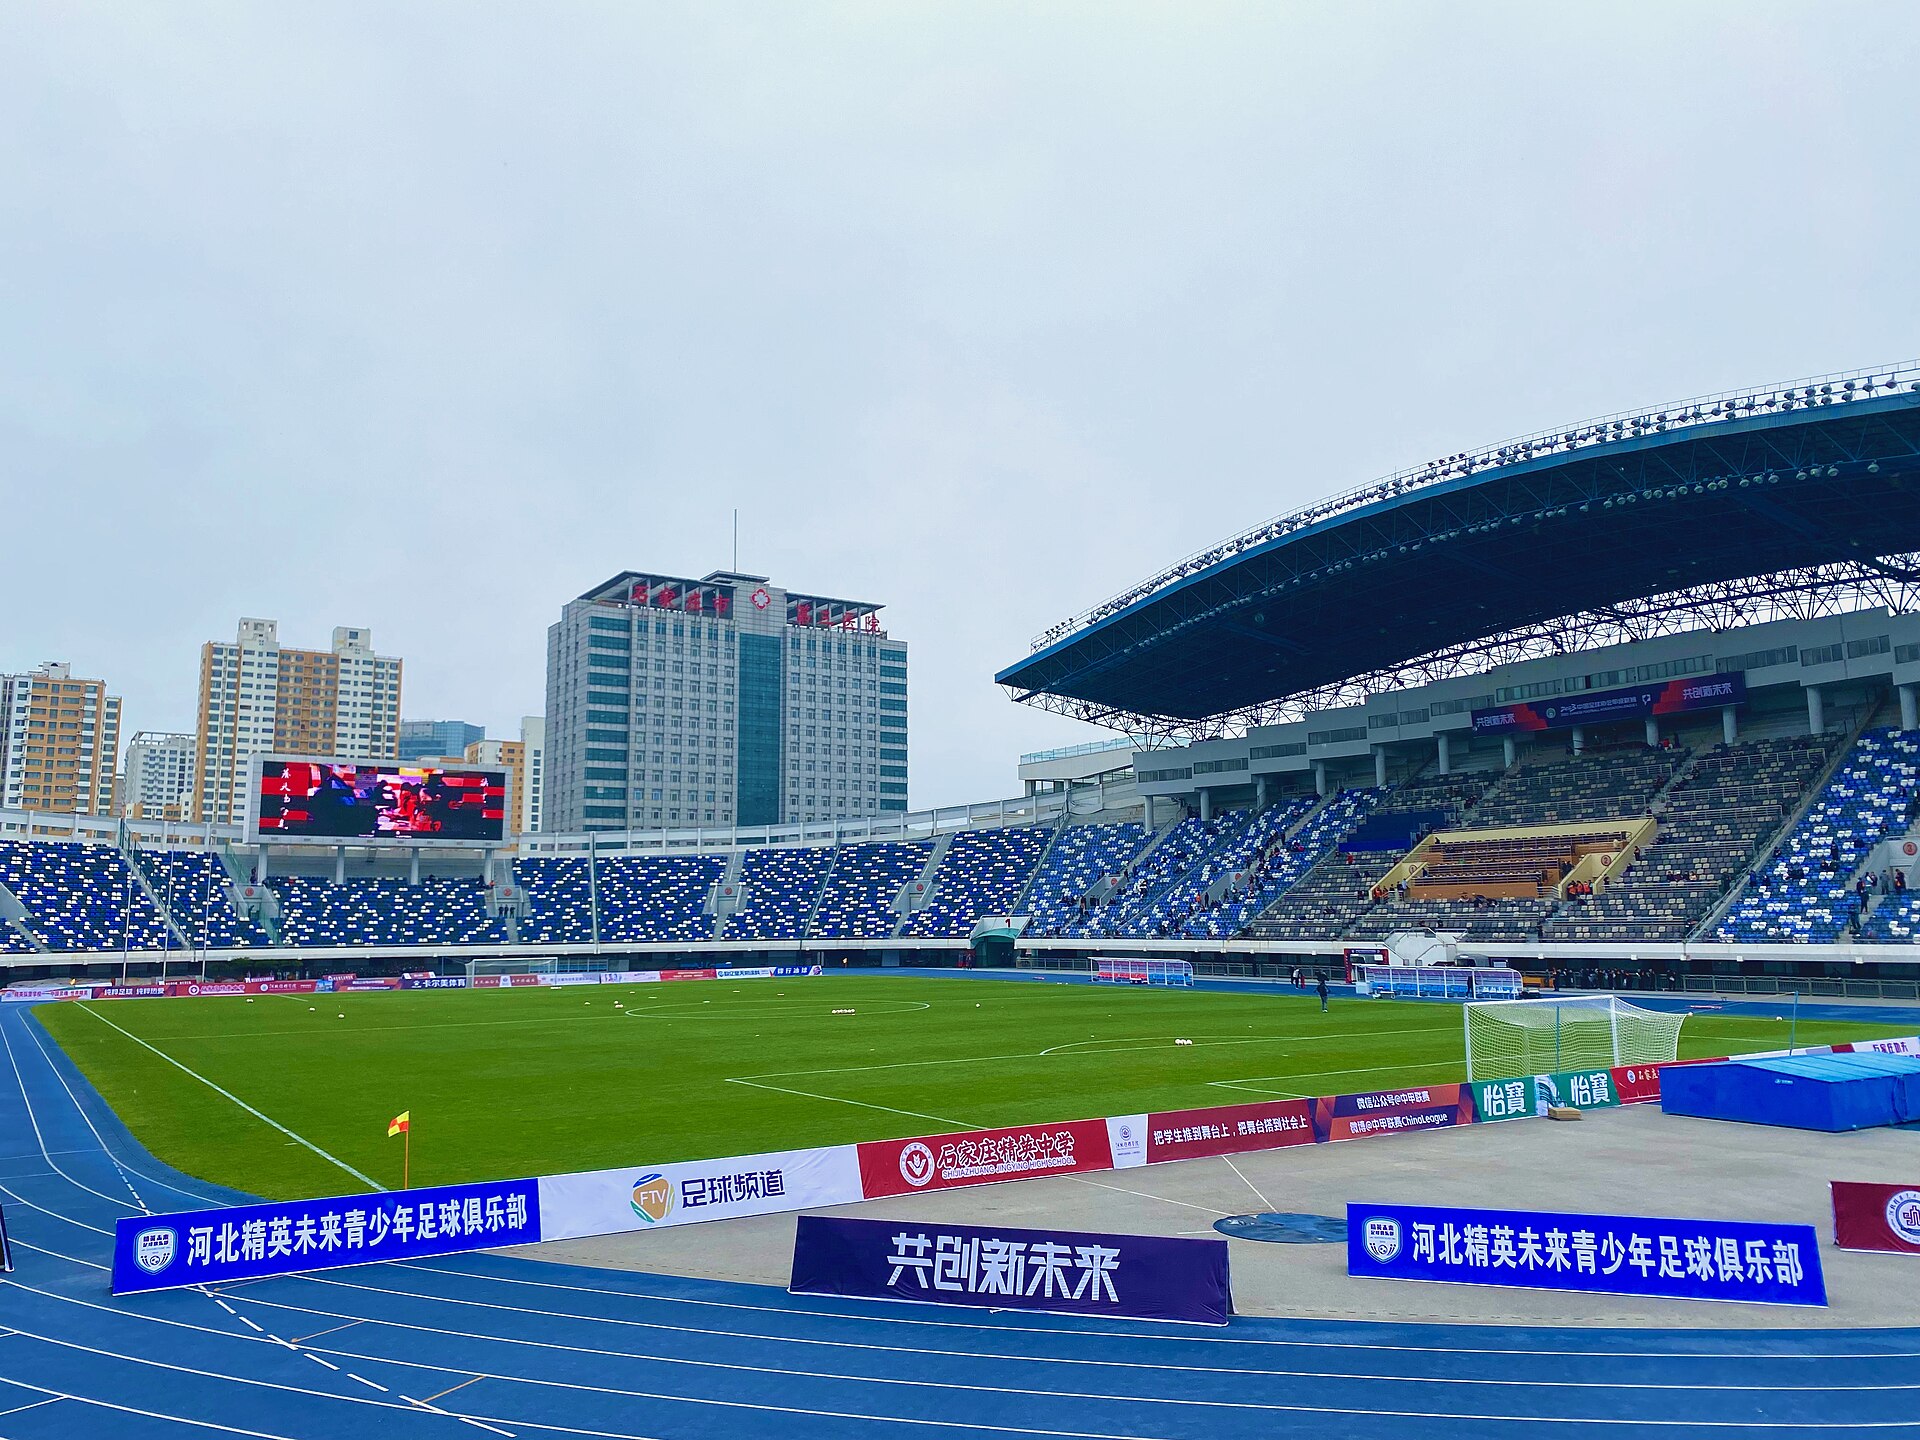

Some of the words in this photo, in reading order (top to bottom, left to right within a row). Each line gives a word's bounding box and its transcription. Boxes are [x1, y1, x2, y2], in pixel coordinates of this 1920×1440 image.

[1005, 918, 1010, 928] 1
[423, 979, 466, 988] 卡尔美体育
[1356, 1091, 1431, 1110] 微信公众号@中甲联赛
[1483, 1081, 1527, 1117] 怡寶
[1570, 1073, 1610, 1106] 怡寶
[937, 1131, 1075, 1169] 石家庄精英中学
[942, 1165, 995, 1179] SHIJIAZHUANG
[996, 1161, 1029, 1174] JINGYING
[1029, 1158, 1046, 1170] HIGH
[1046, 1156, 1076, 1168] SCHOOL
[640, 1188, 667, 1206] FTV
[681, 1169, 785, 1208] 足球频道
[187, 1193, 528, 1266] 河北精英未来青少年足球俱乐部
[886, 1232, 1121, 1303] 共创新未来
[1412, 1221, 1803, 1287] 河北精英未来青少年足球俱乐部
